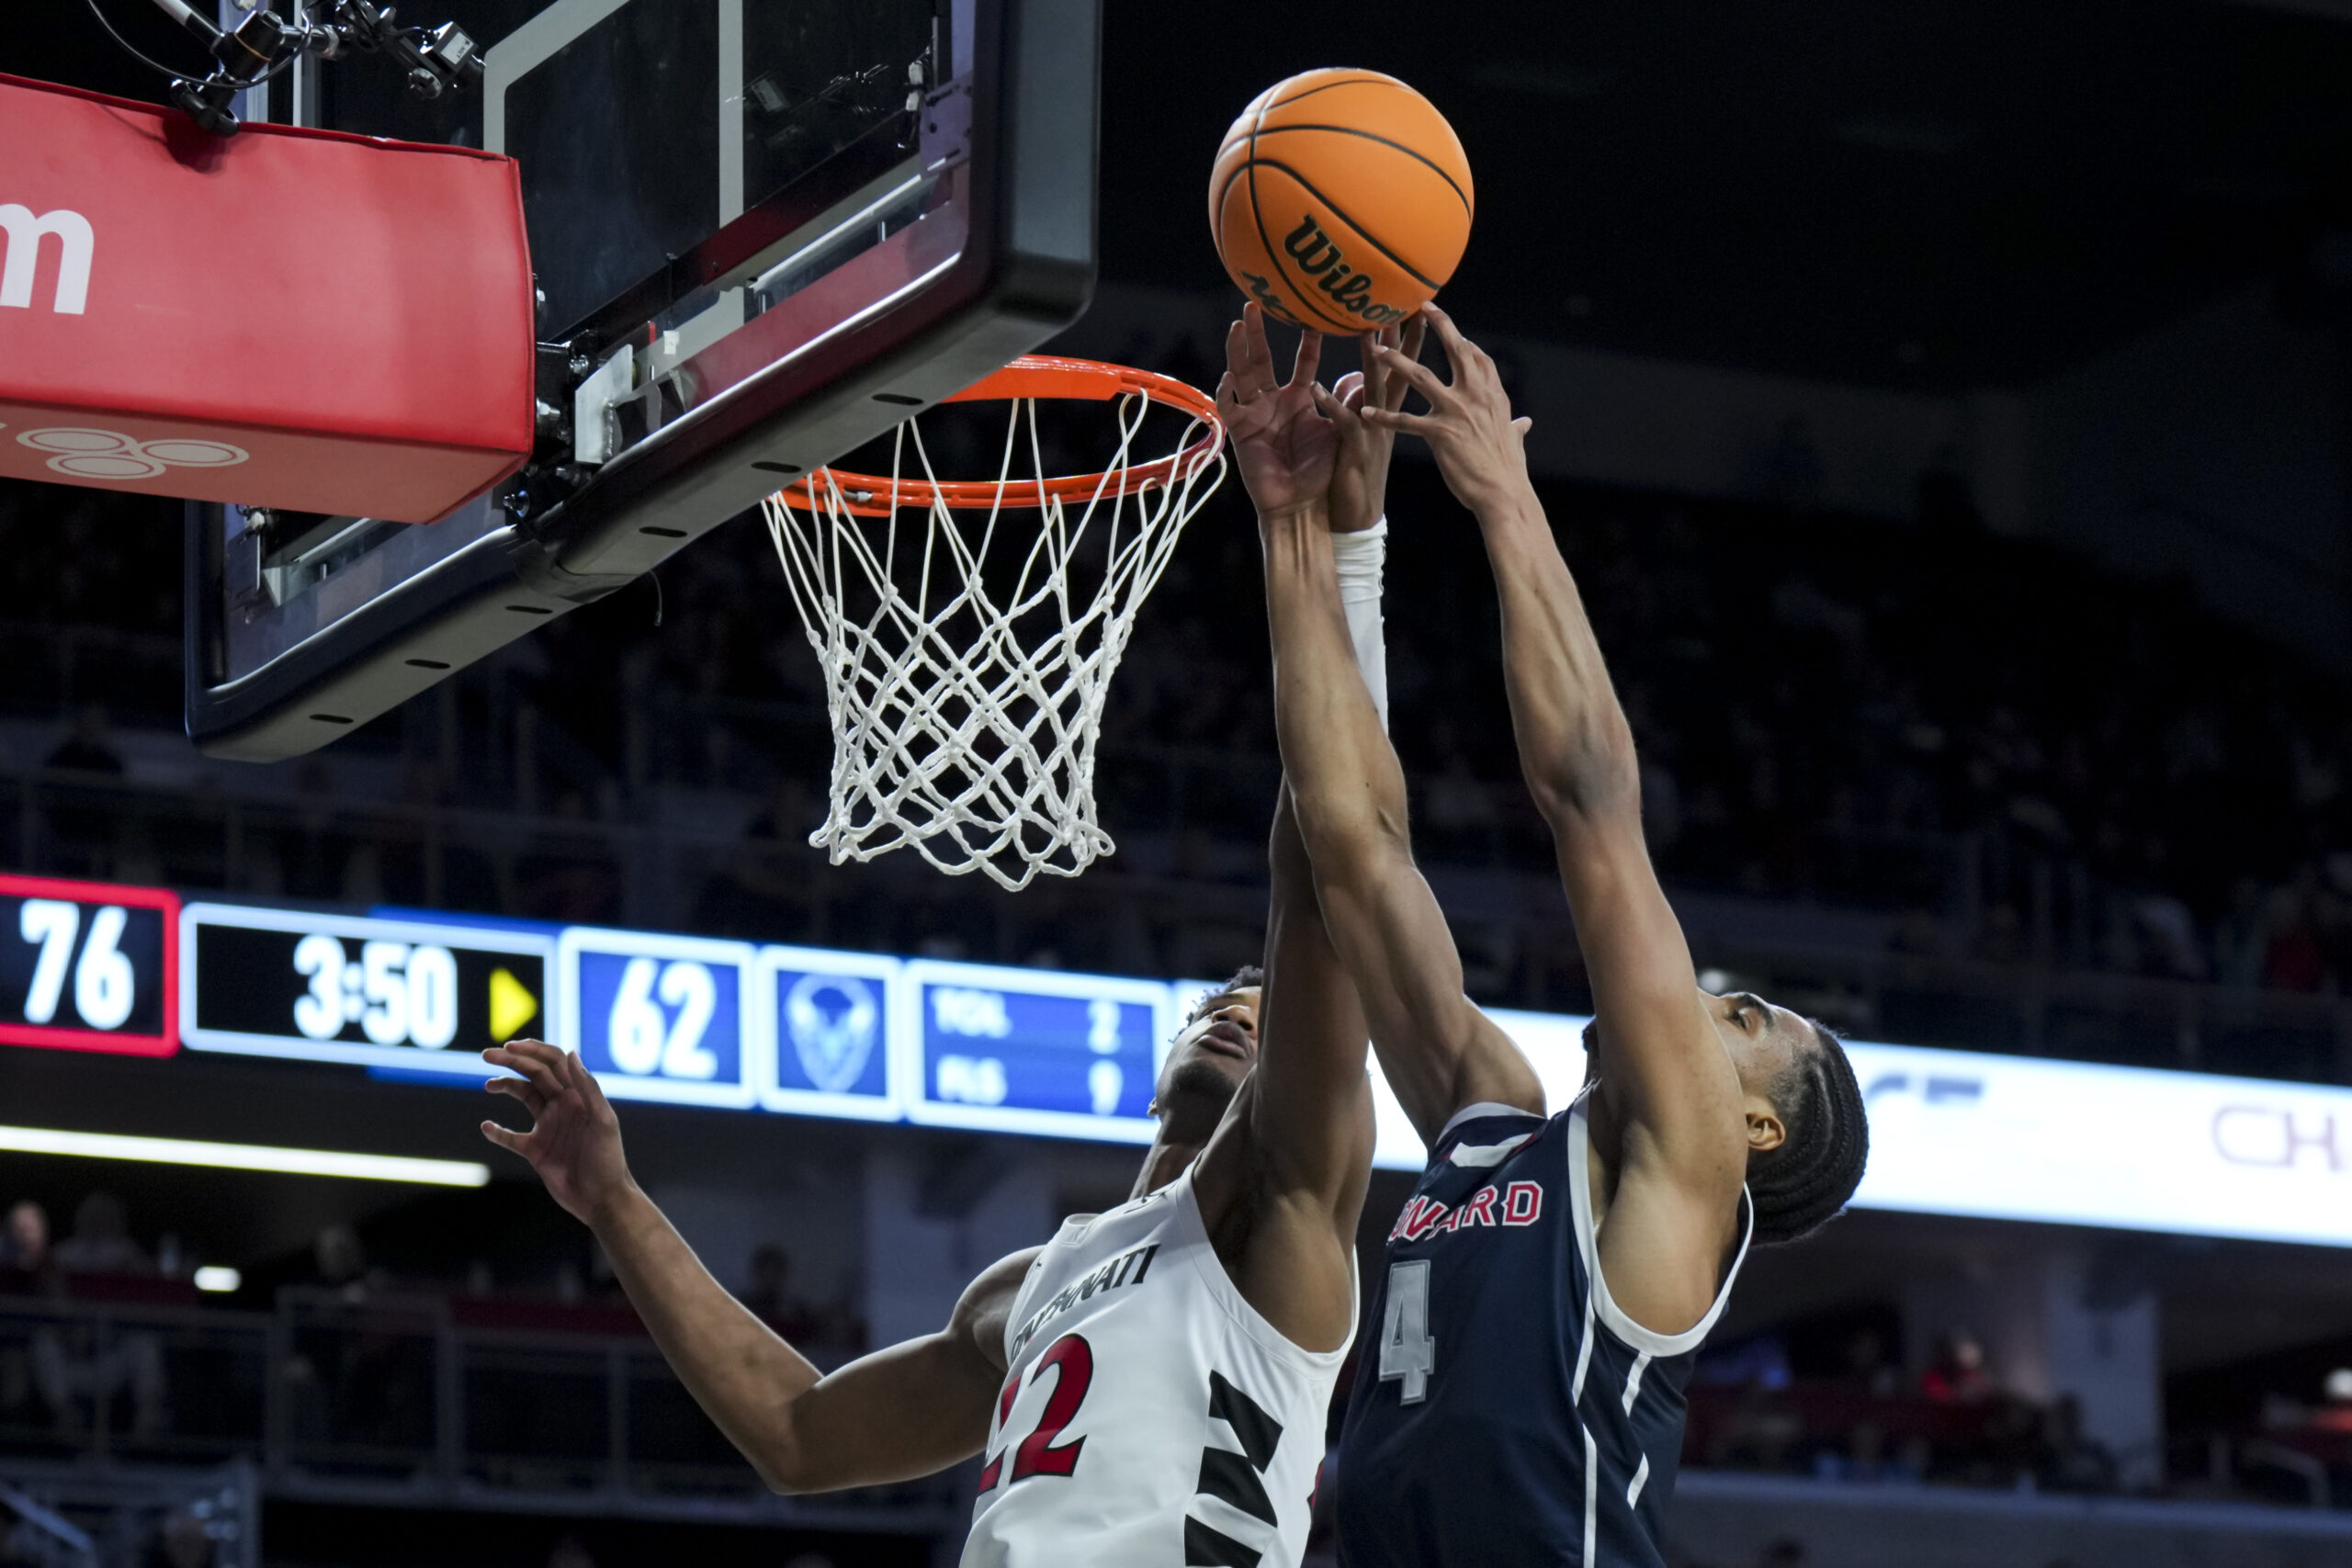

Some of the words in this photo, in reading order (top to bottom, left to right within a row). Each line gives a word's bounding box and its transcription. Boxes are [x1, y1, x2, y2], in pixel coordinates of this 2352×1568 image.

[1284, 212, 1408, 325] Wilson
[20, 897, 134, 1031] 76
[293, 934, 458, 1050] 3:50
[607, 956, 718, 1080] 62
[1386, 1180, 1544, 1242] OWARD
[1379, 1259, 1435, 1405] 4
